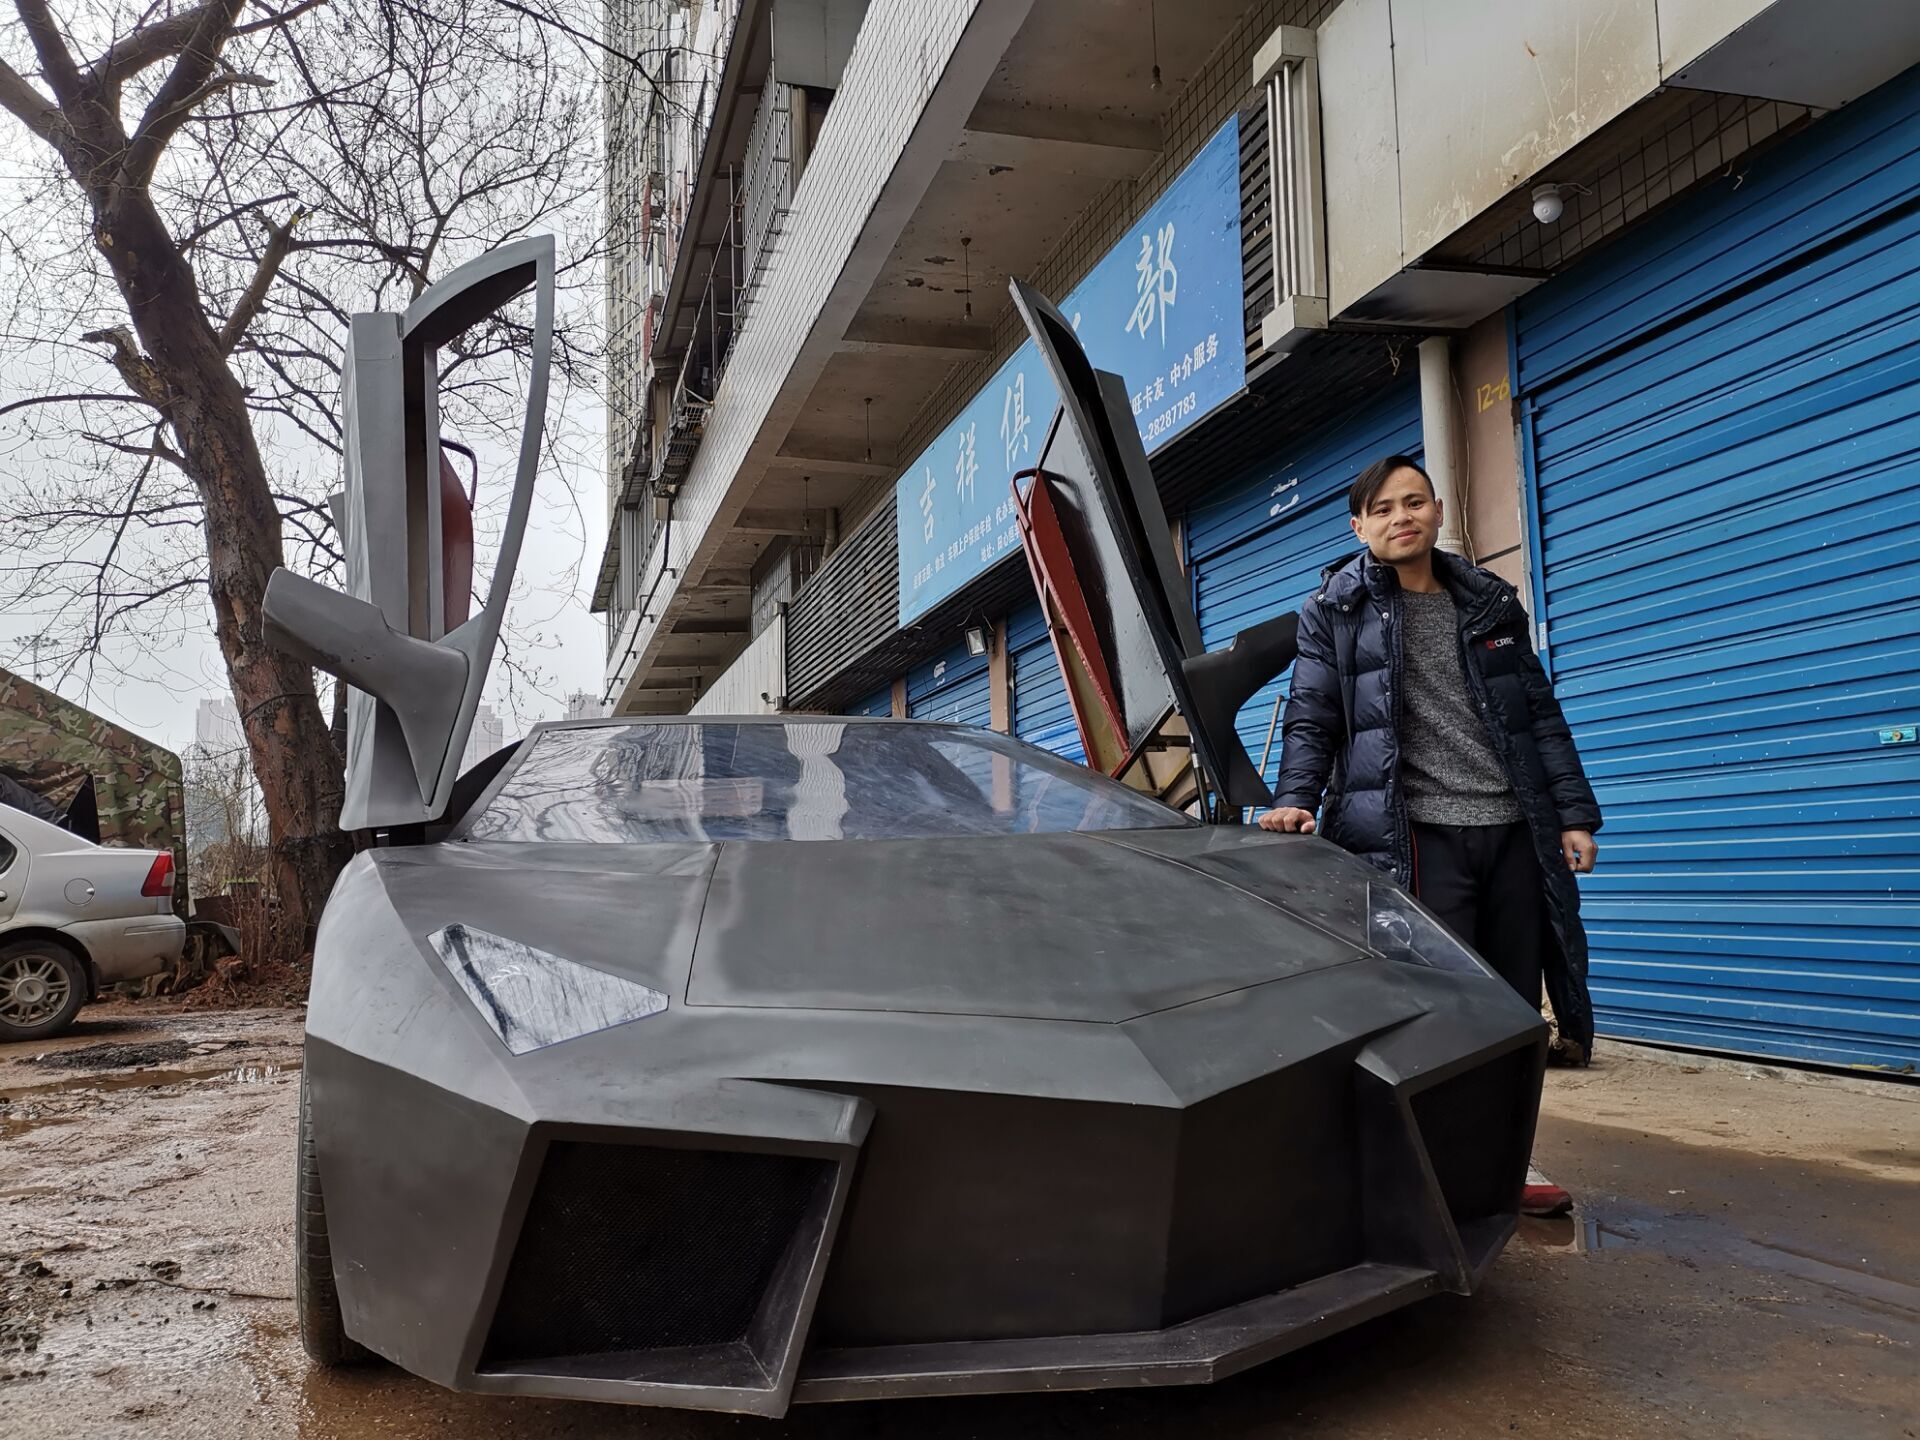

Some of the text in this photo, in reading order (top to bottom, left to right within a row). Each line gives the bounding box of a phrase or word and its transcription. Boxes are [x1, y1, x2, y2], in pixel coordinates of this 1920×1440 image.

[1170, 333, 1219, 388] 中介服务
[1477, 374, 1510, 413] 12-6
